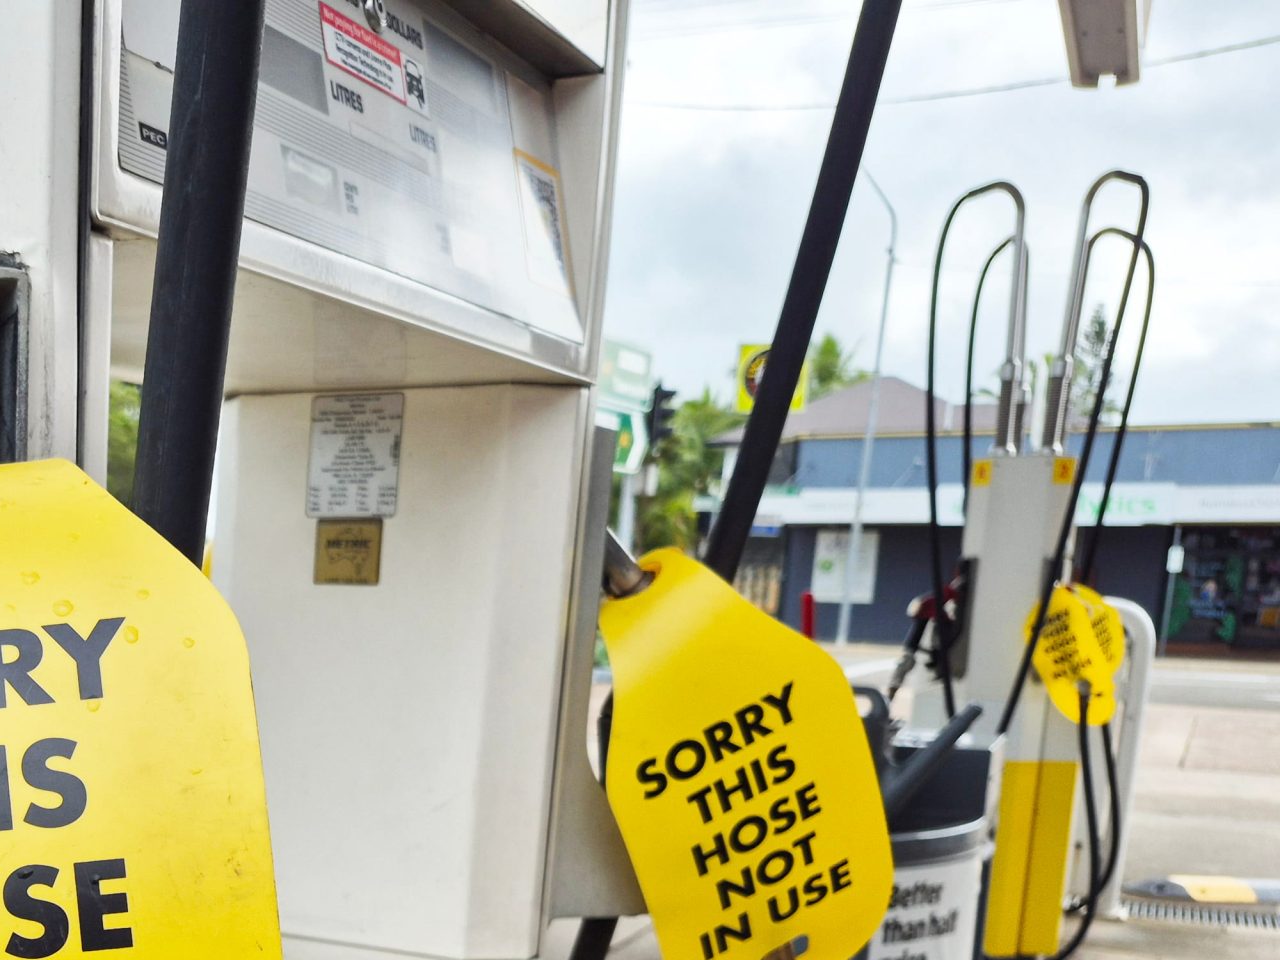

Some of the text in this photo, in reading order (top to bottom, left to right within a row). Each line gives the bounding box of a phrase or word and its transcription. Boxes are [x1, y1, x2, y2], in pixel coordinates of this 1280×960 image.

[330, 80, 364, 113] LITRES
[636, 681, 794, 800] SORRY
[687, 744, 796, 824] THIS
[691, 782, 822, 877] HOSE
[716, 832, 816, 910] NOT
[767, 858, 852, 924] USE
[888, 880, 944, 909] Better
[882, 910, 959, 943] than half
